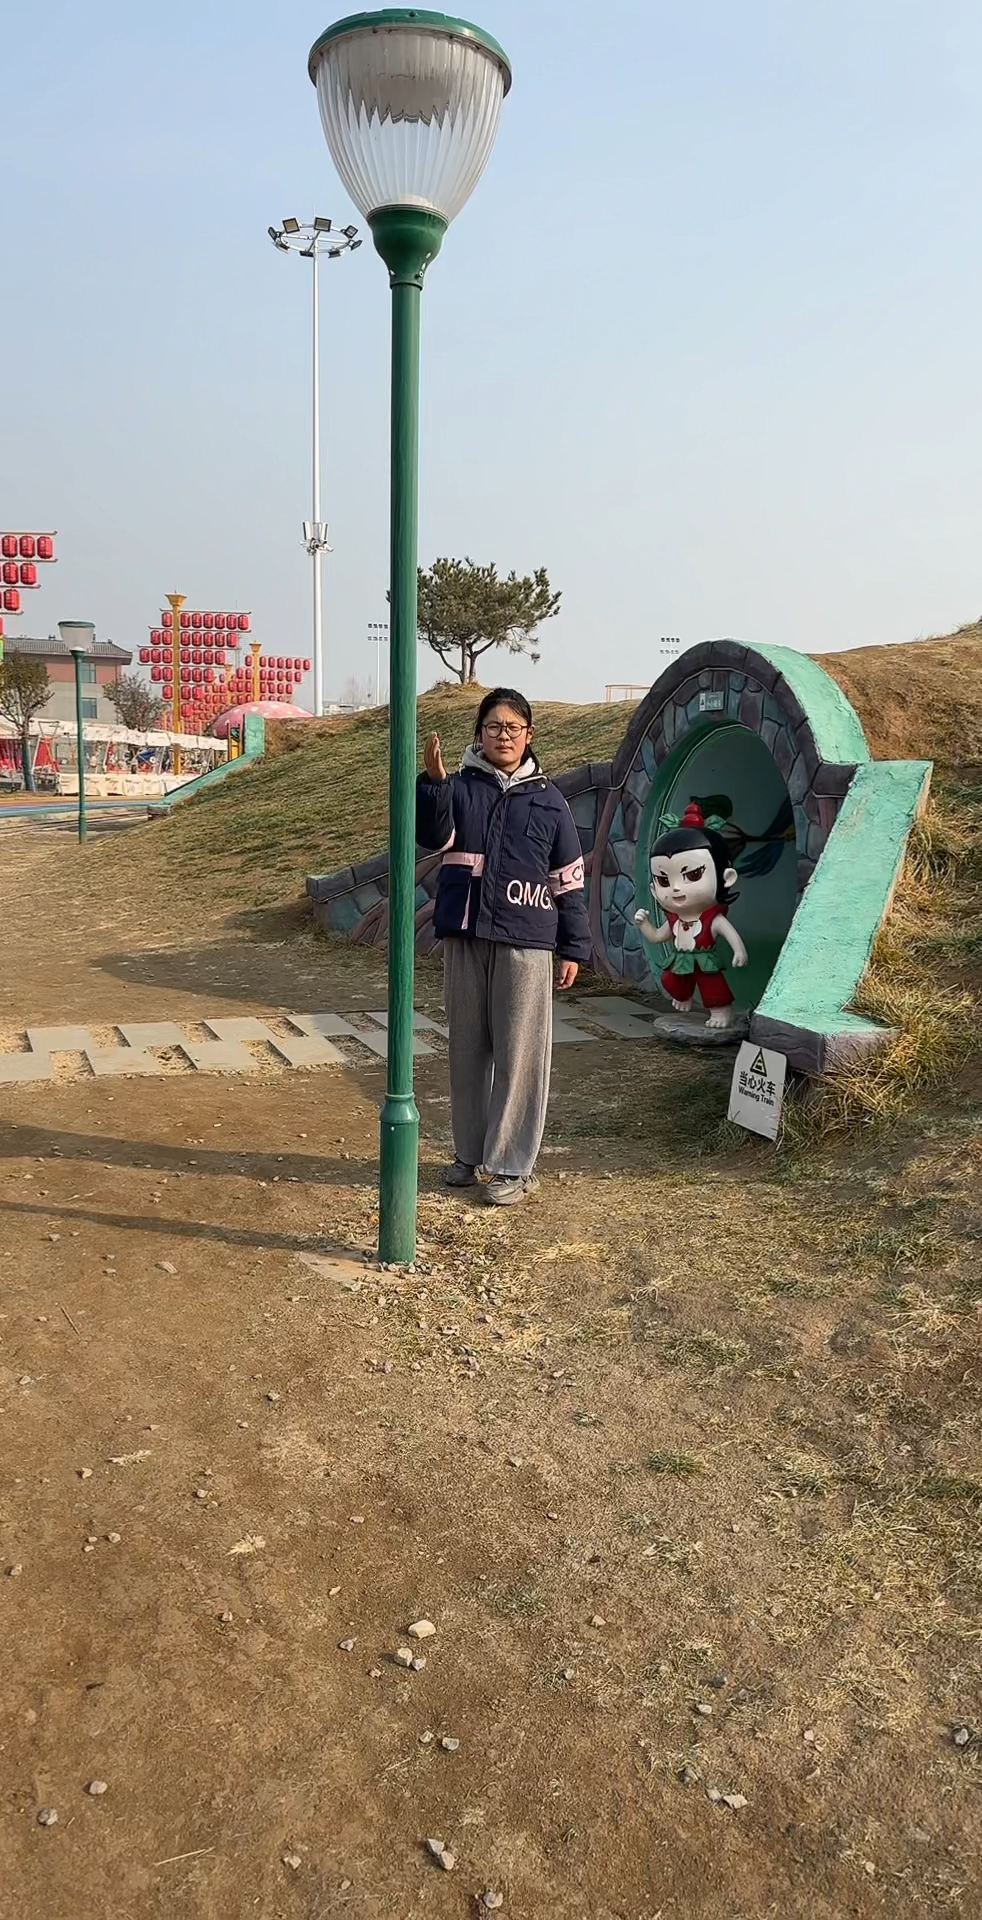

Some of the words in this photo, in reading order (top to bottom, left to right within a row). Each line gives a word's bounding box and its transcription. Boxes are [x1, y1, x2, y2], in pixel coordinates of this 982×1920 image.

[559, 864, 584, 886] LC
[739, 1071, 776, 1096] 当心火车
[760, 1094, 775, 1106] Train
